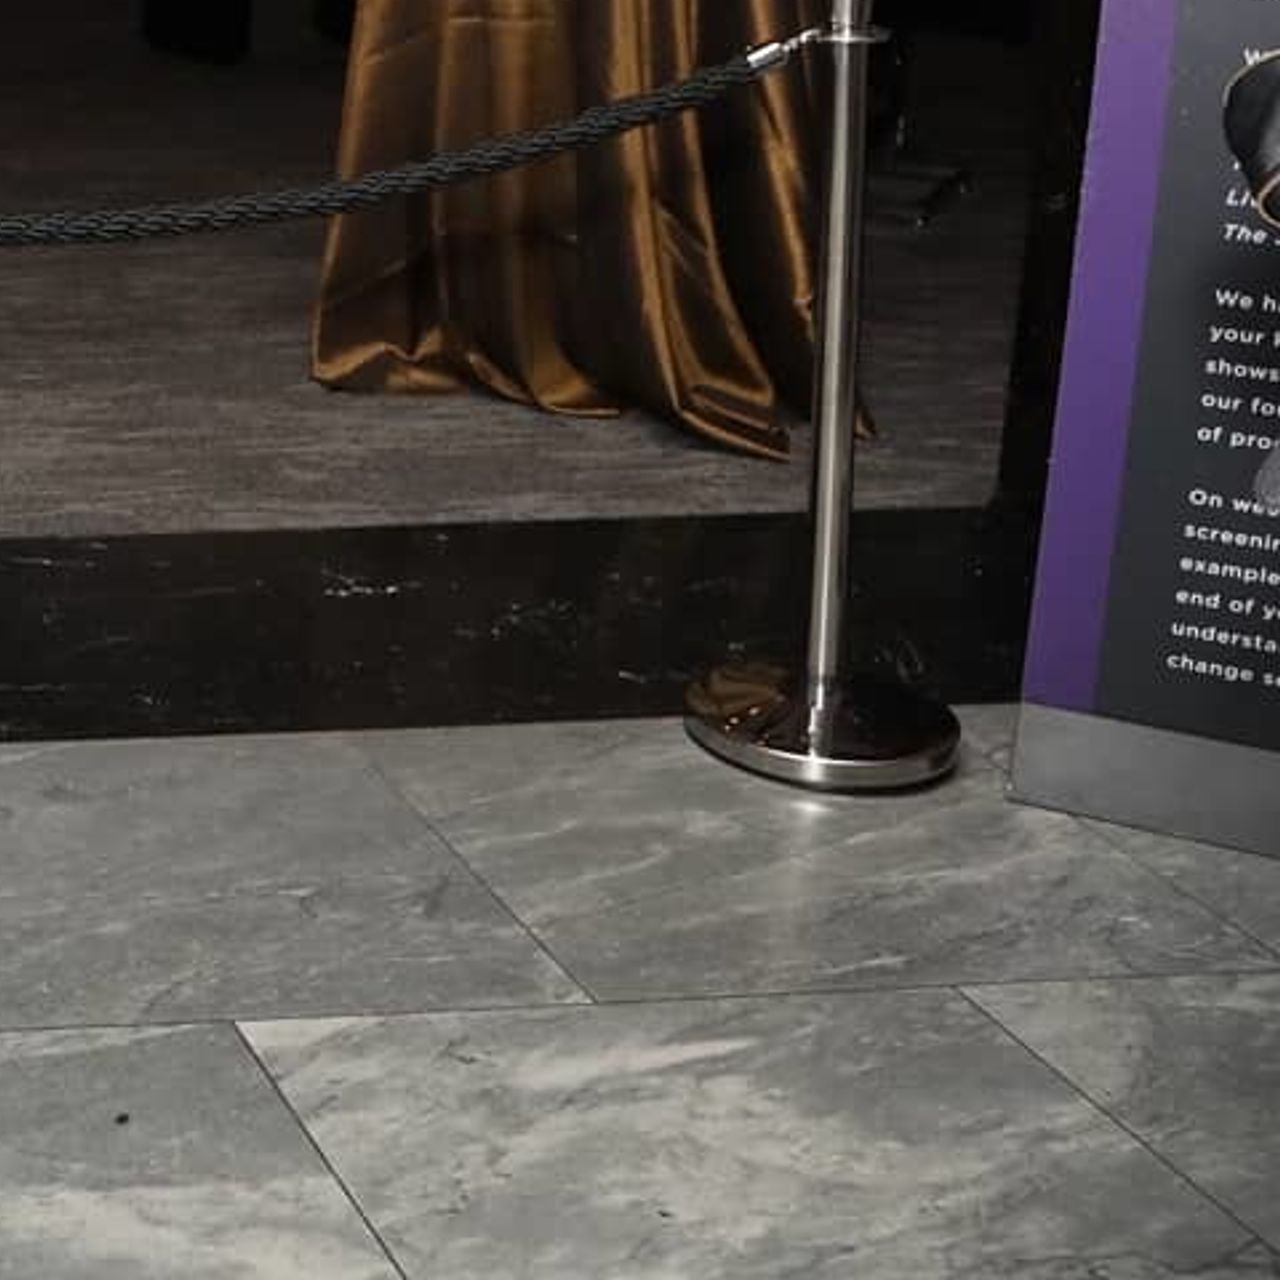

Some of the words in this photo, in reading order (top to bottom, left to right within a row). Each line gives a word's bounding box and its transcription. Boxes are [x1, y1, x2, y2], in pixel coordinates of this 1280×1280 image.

[1224, 223, 1268, 245] The
[1215, 288, 1253, 310] We
[1209, 323, 1264, 345] your
[1205, 357, 1280, 383] shows
[1201, 393, 1243, 412] our
[1196, 425, 1223, 444] of
[1187, 488, 1223, 509] On
[1175, 589, 1221, 610] end
[1228, 598, 1255, 616] of
[1166, 651, 1255, 683] change
